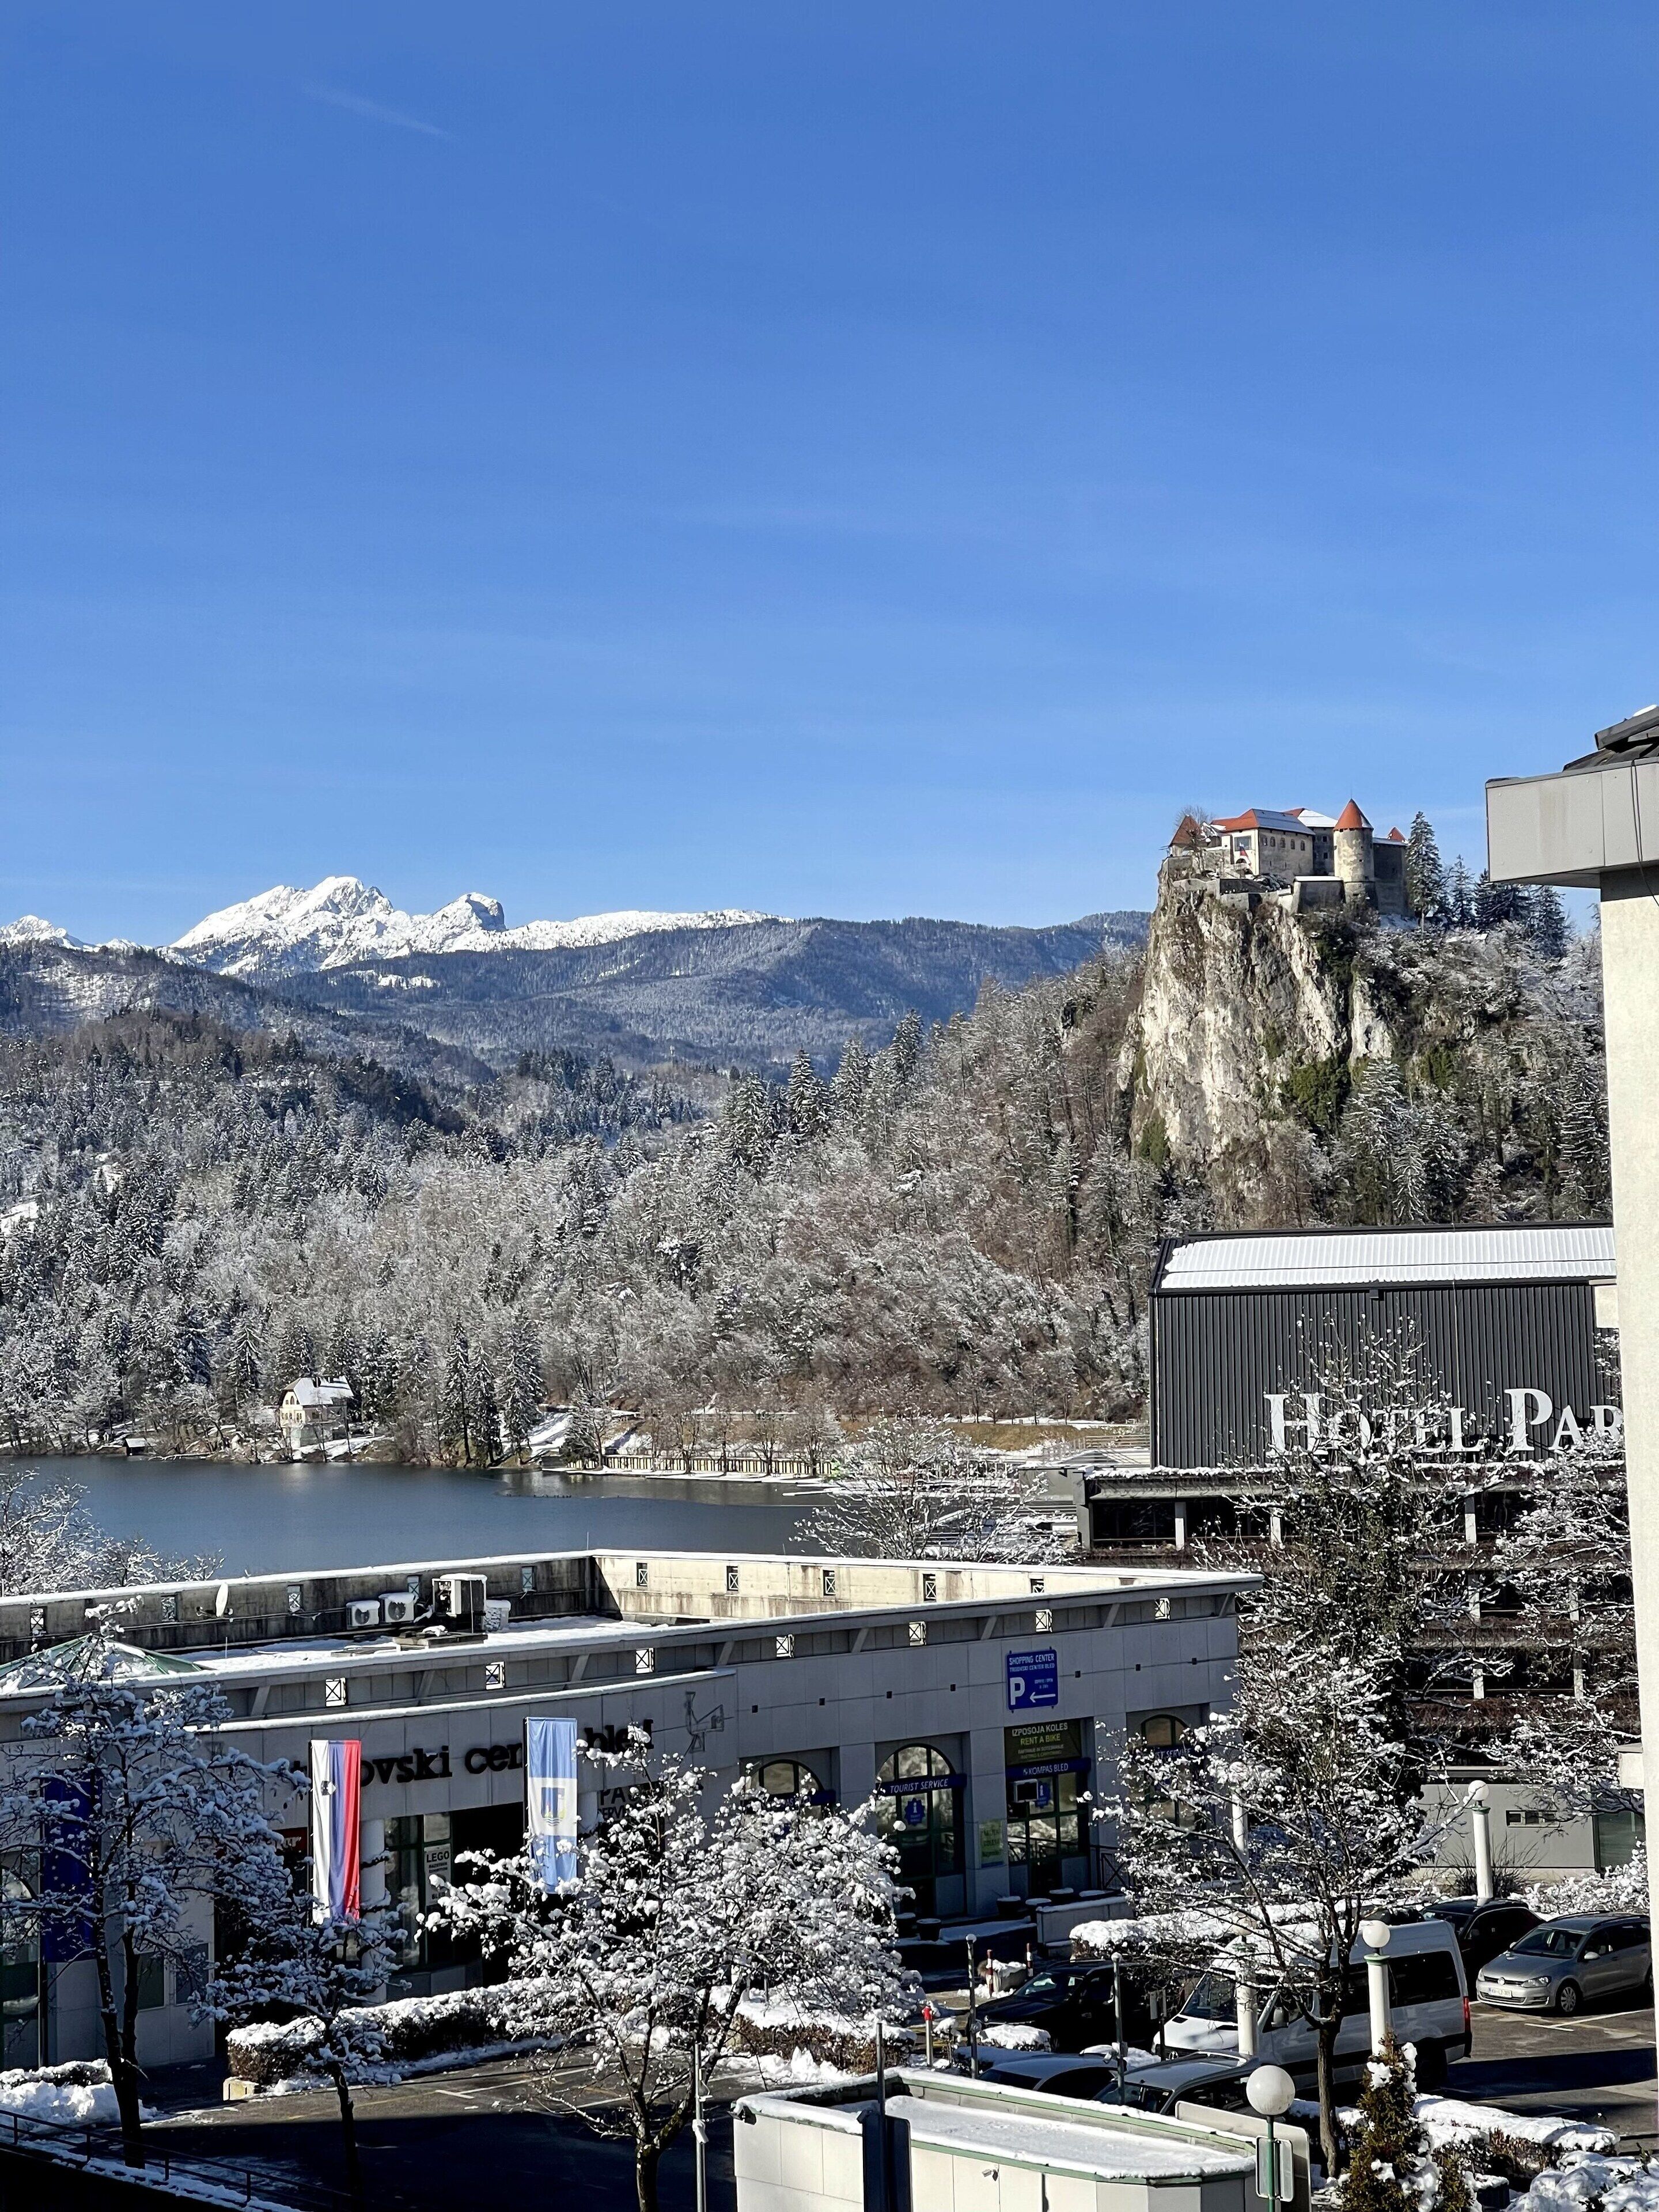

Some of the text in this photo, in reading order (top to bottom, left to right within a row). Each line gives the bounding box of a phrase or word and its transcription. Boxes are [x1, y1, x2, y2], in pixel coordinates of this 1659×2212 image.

[1009, 1653, 1054, 1665] SHOPPING CENTER
[1010, 1677, 1025, 1706] P
[1012, 1722, 1068, 1737] IZPOSOJA KOLES
[1020, 1736, 1038, 1745] RENT
[1046, 1733, 1060, 1743] BIKE
[1029, 1763, 1069, 1775] KOMPAS BLED
[890, 1778, 949, 1794] TOURIST SERVICE
[426, 1851, 449, 1863] LEGO
